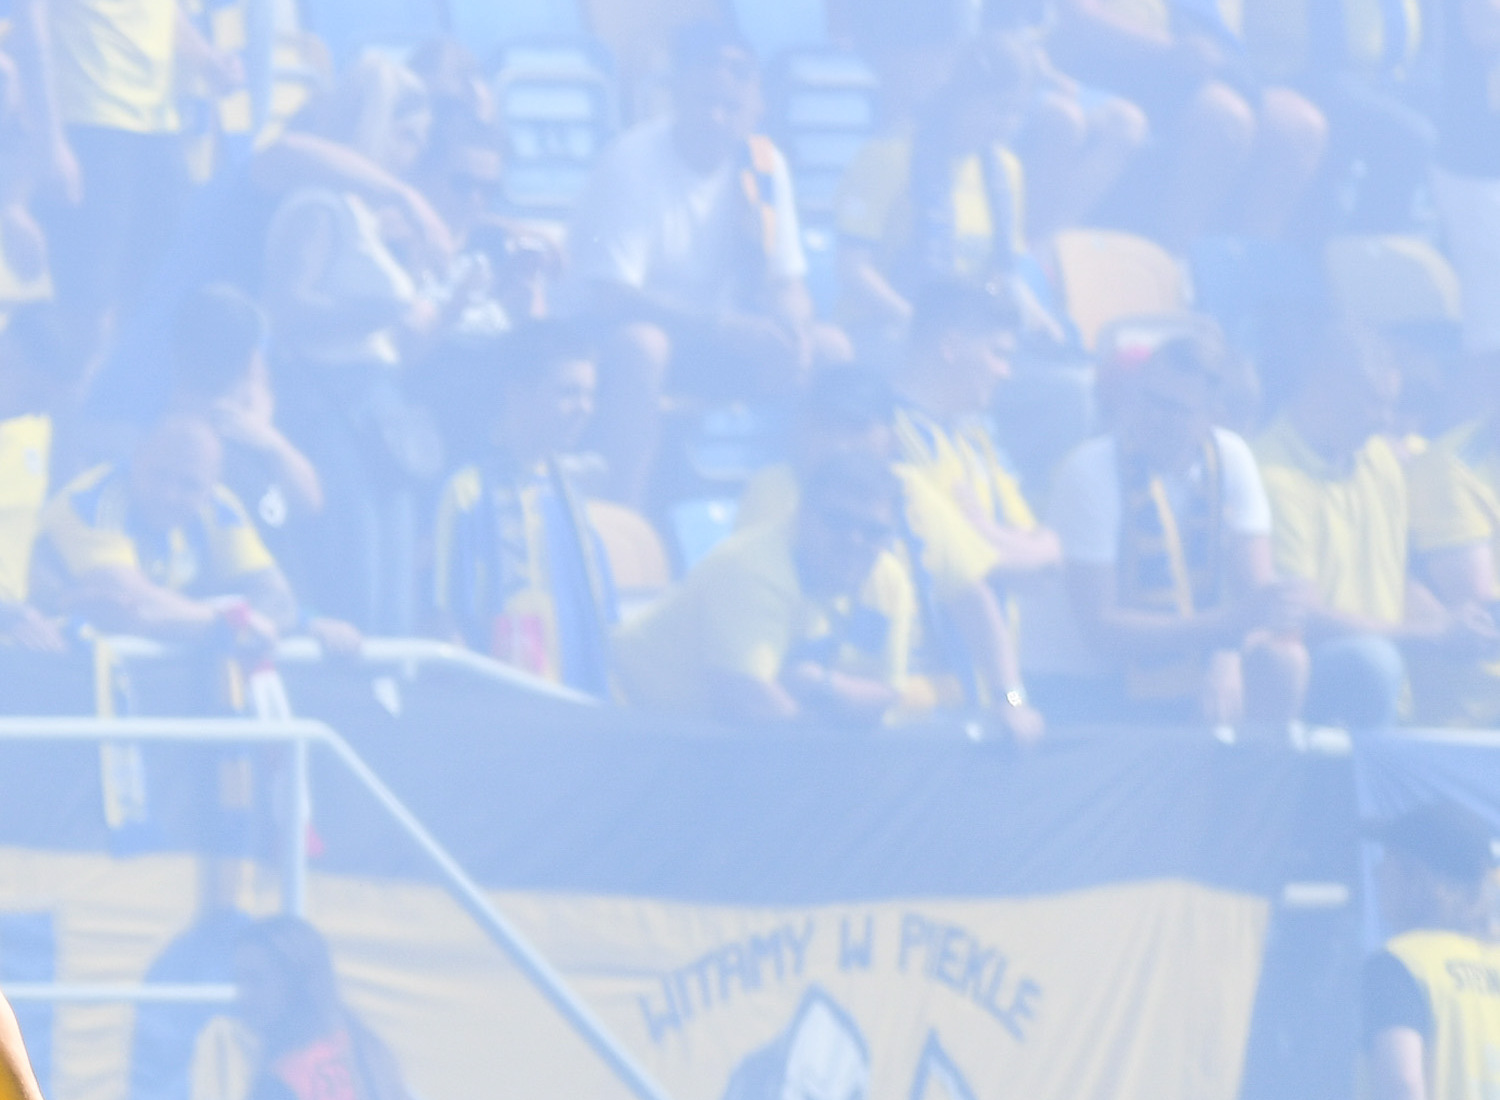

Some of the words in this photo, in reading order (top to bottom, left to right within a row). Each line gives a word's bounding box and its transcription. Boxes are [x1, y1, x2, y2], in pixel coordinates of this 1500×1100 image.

[637, 922, 816, 1046] WITAMY
[839, 914, 874, 970] W
[898, 913, 1042, 1043] PIEKLE
